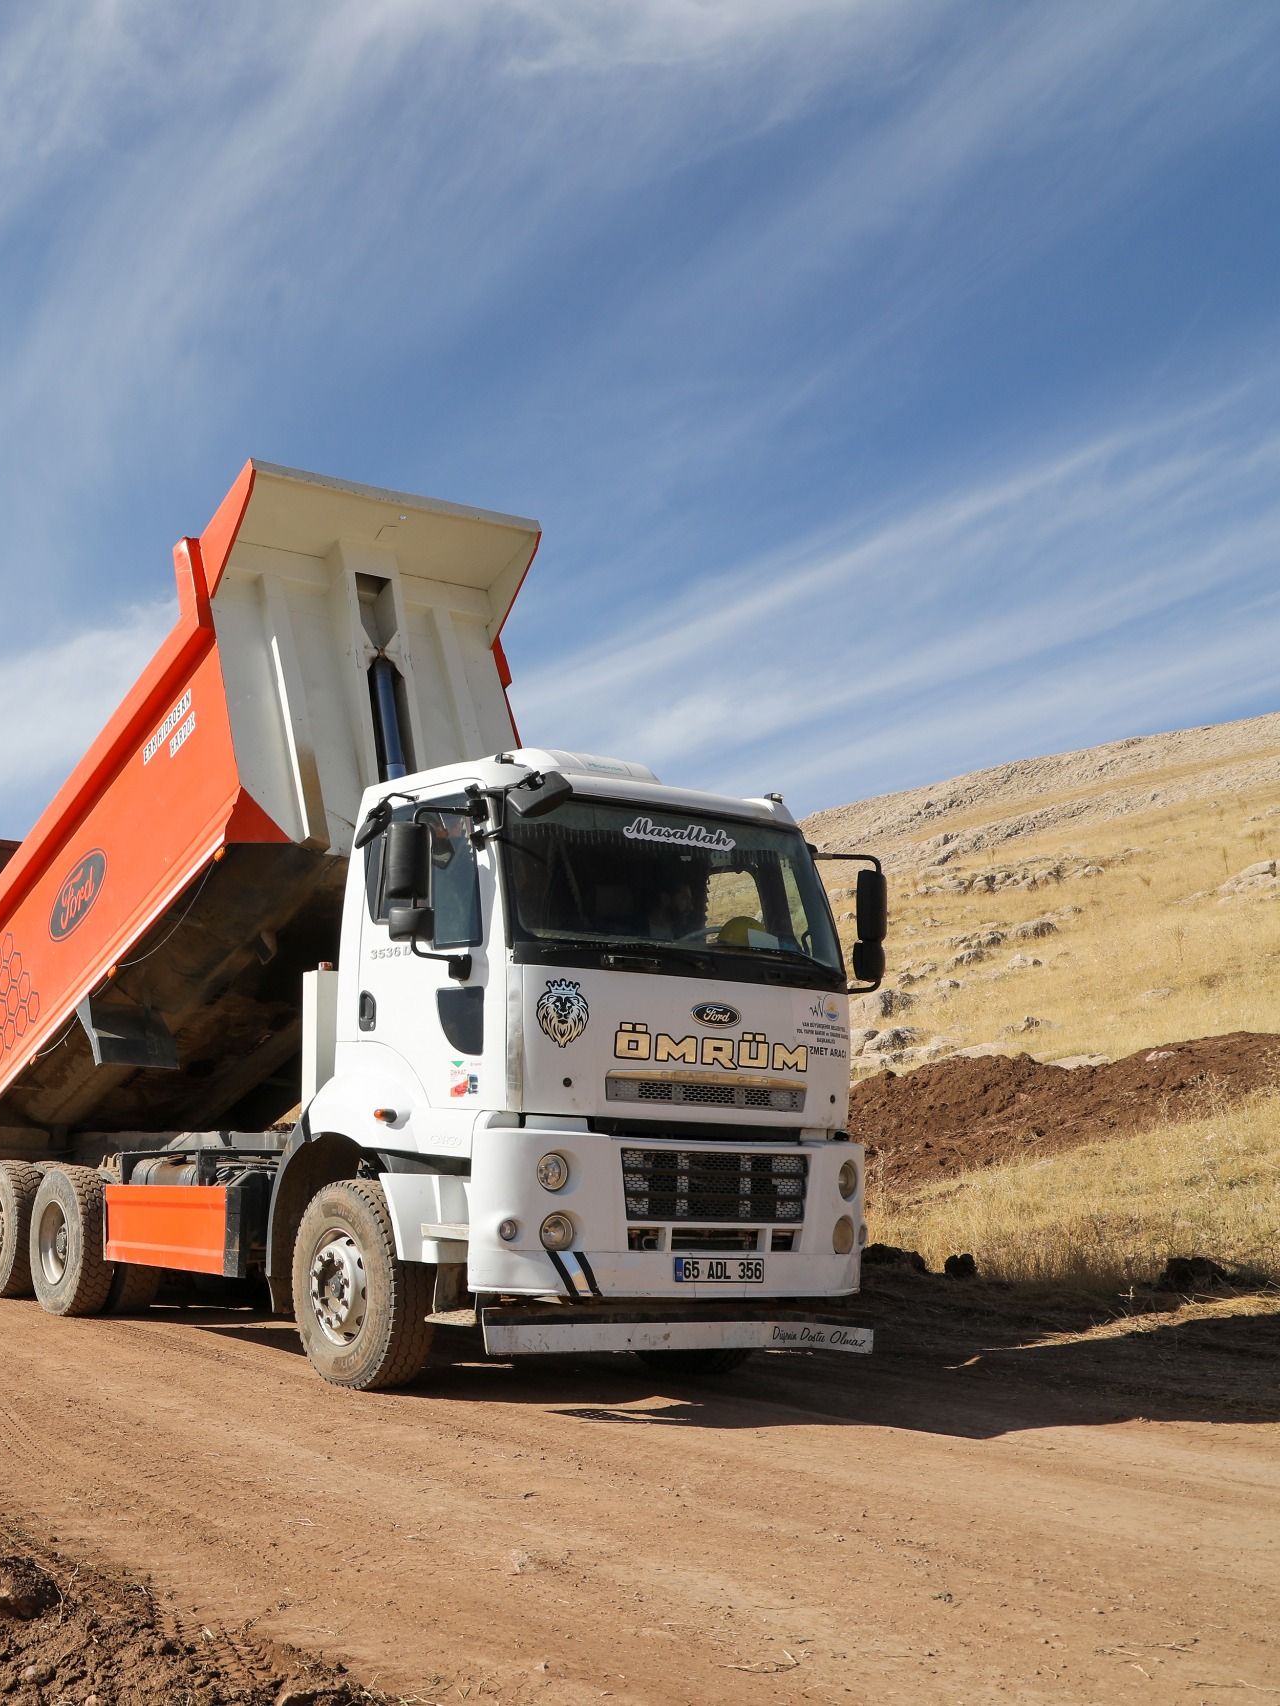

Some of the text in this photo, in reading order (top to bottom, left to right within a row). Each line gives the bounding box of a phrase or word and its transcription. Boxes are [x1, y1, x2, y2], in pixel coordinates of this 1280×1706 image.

[702, 1003, 730, 1023] Ford
[614, 1022, 808, 1072] ÖMRÜM
[809, 1046, 828, 1056] ZMET
[683, 1261, 762, 1279] 65 ADL 356
[800, 1327, 825, 1343] Dostu
[829, 1331, 866, 1347] Olmaz
